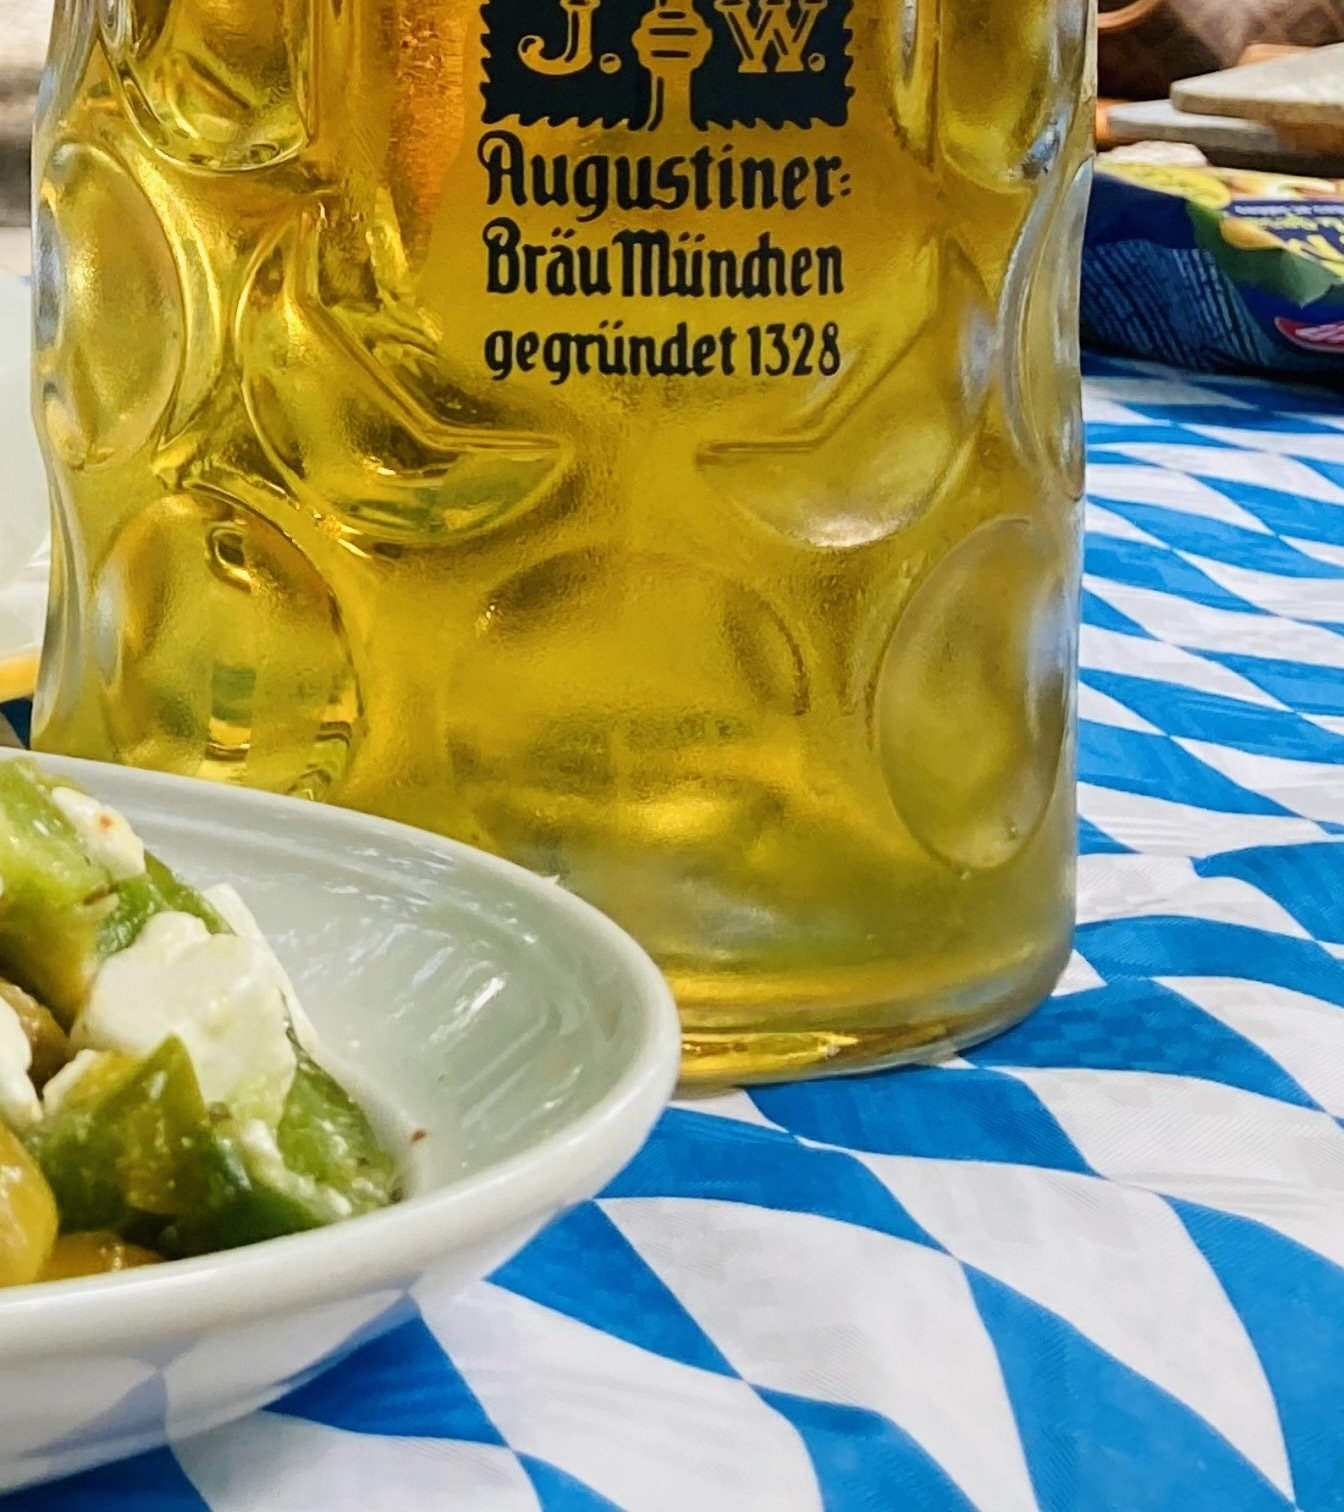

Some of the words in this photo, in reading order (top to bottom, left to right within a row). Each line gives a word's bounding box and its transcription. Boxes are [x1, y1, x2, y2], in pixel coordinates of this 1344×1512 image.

[480, 214, 611, 297] Bräu
[612, 227, 846, 299] München
[483, 319, 739, 387] gegründet
[749, 321, 842, 379] 1328
